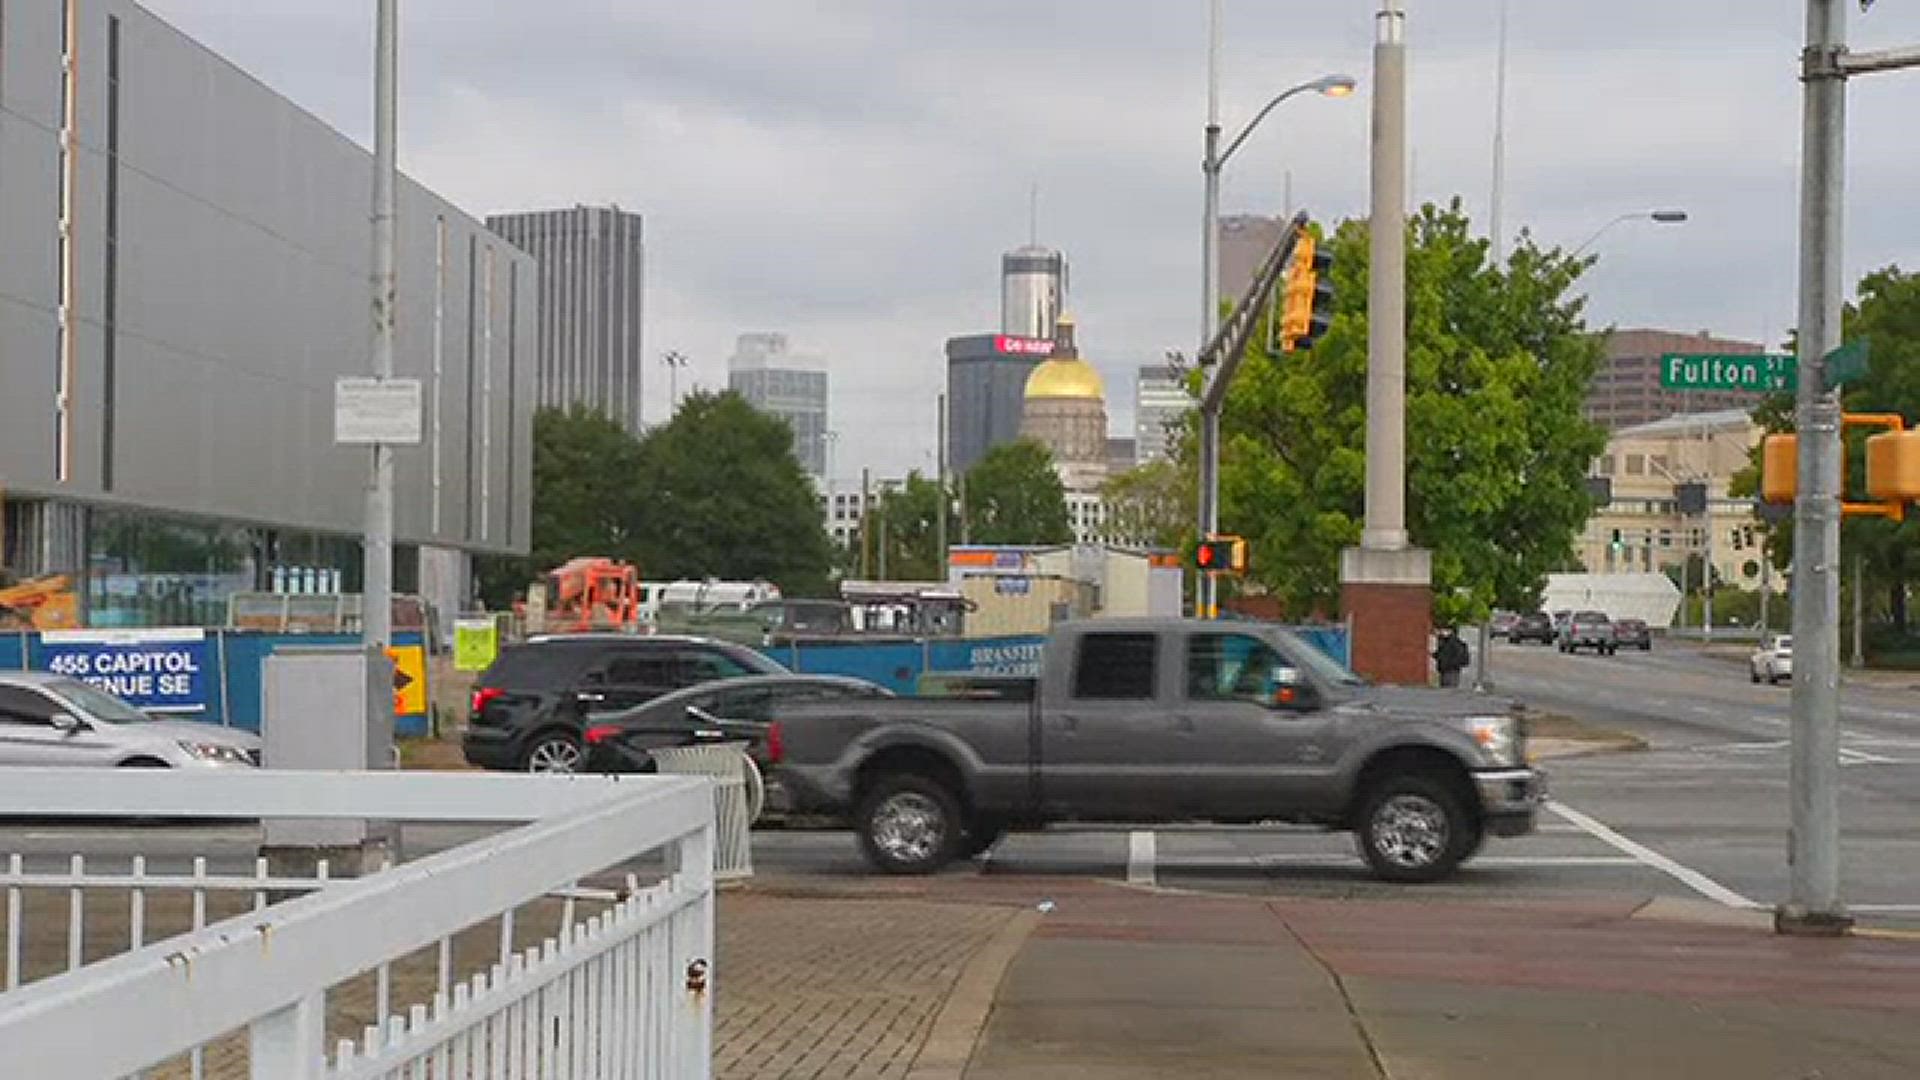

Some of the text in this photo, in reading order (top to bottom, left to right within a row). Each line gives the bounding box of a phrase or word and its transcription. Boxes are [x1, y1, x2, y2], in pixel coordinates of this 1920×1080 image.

[1669, 357, 1784, 383] Fulton ST
[1765, 375, 1785, 390] SW
[50, 652, 199, 674] 455 CAPITOL
[83, 673, 191, 695] ENUE SE
